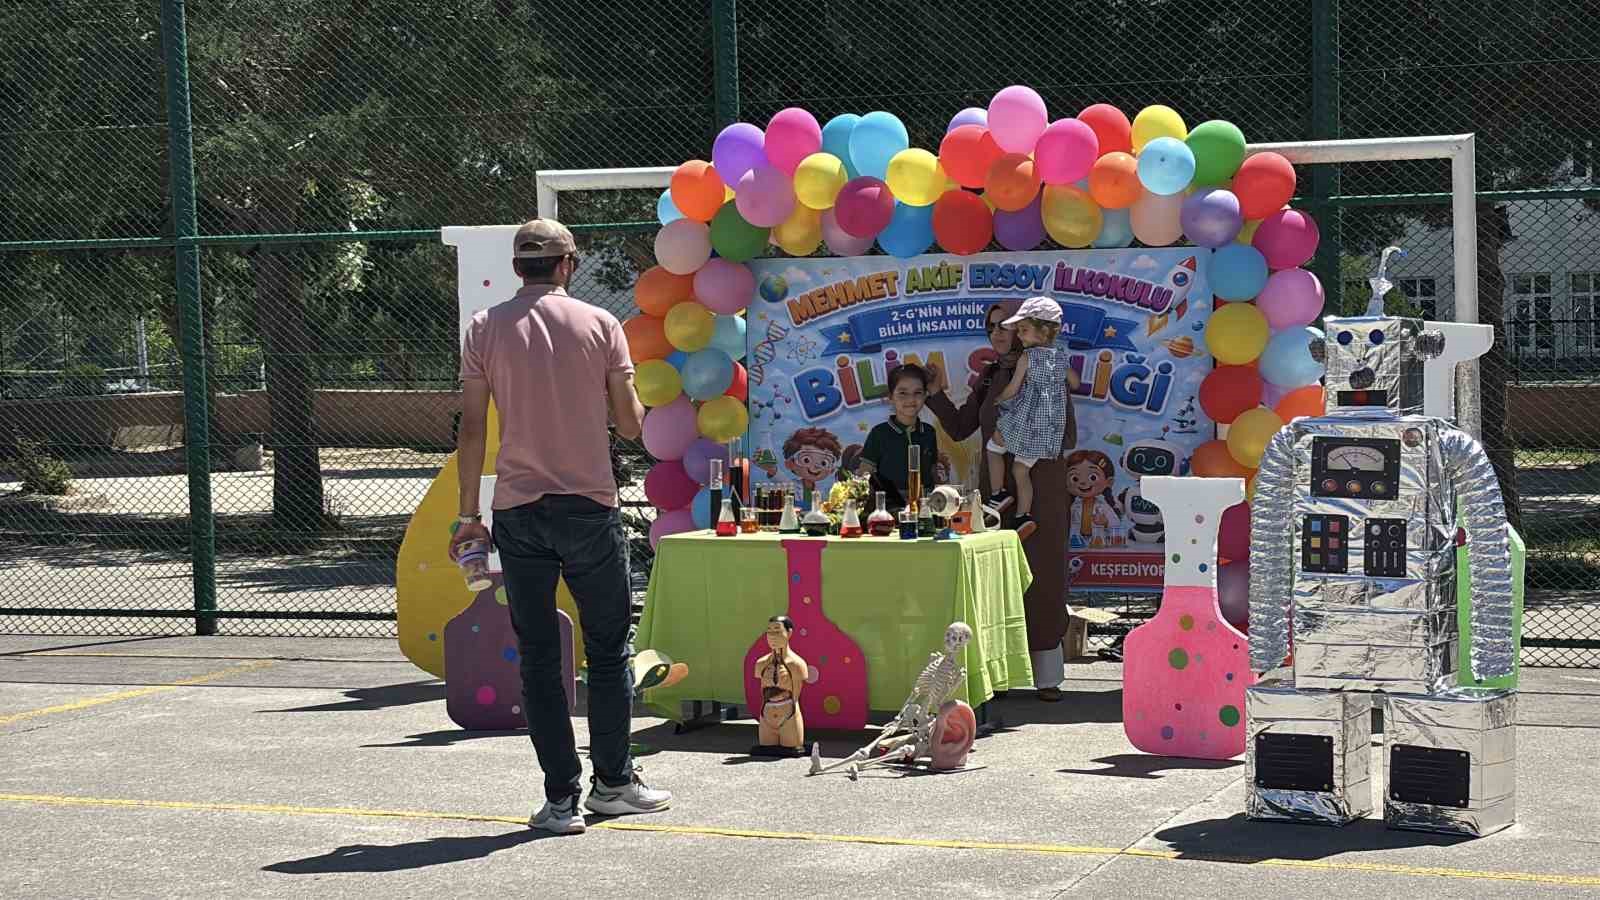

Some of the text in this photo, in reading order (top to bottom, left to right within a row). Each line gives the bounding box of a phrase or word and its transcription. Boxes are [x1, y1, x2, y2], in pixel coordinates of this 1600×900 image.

[786, 260, 1175, 326] MEHMET AKİF ERSOY İLKOKULU
[891, 302, 985, 322] 2-G'NİN MİNİK
[878, 318, 1076, 338] BİLİM İNSANI OL A!
[967, 347, 1173, 413] LİĞİ
